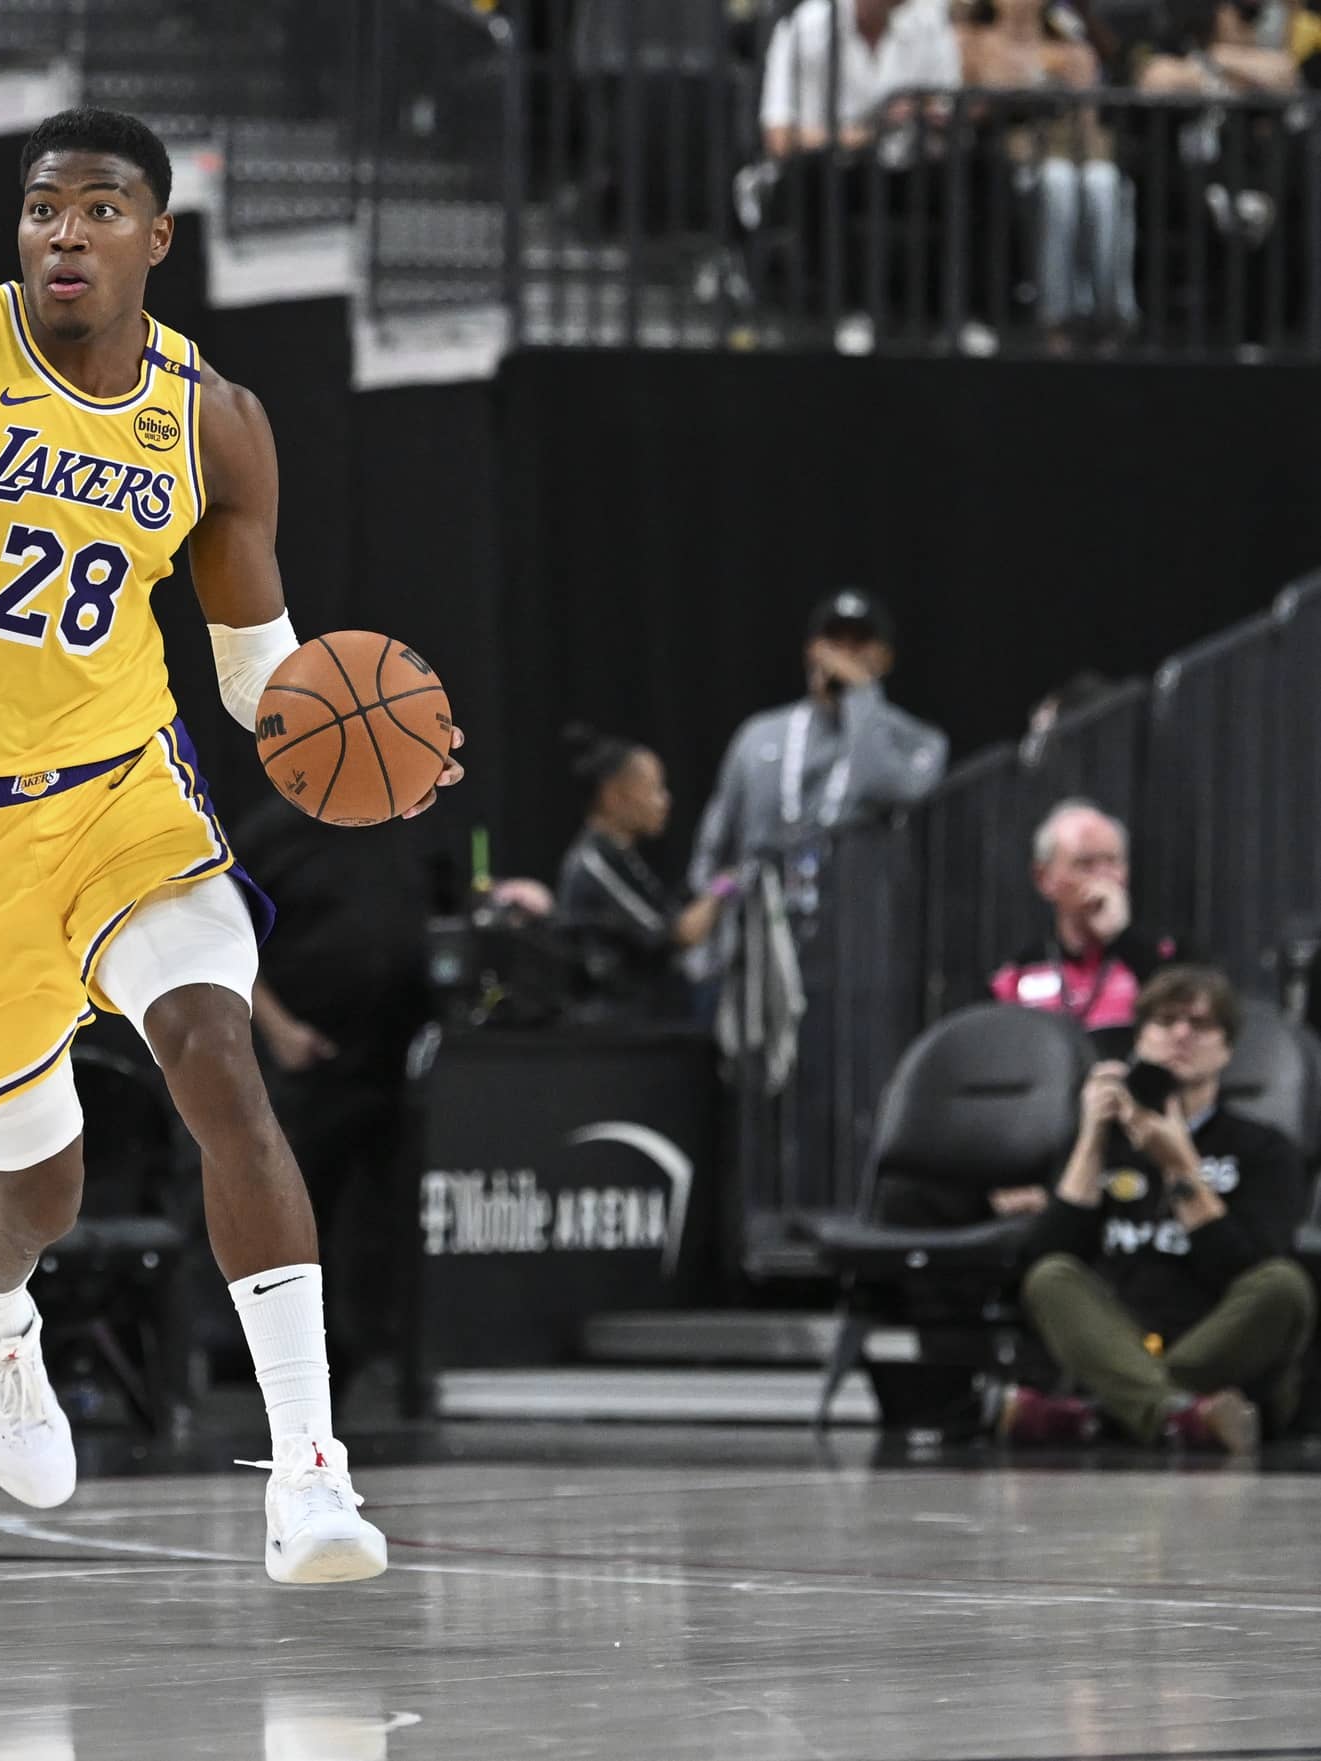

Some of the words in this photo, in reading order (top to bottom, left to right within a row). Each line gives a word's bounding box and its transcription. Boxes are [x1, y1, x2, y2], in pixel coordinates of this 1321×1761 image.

[164, 361, 180, 375] 44
[138, 417, 178, 441] bibigo
[553, 1187, 666, 1251] ARENA
